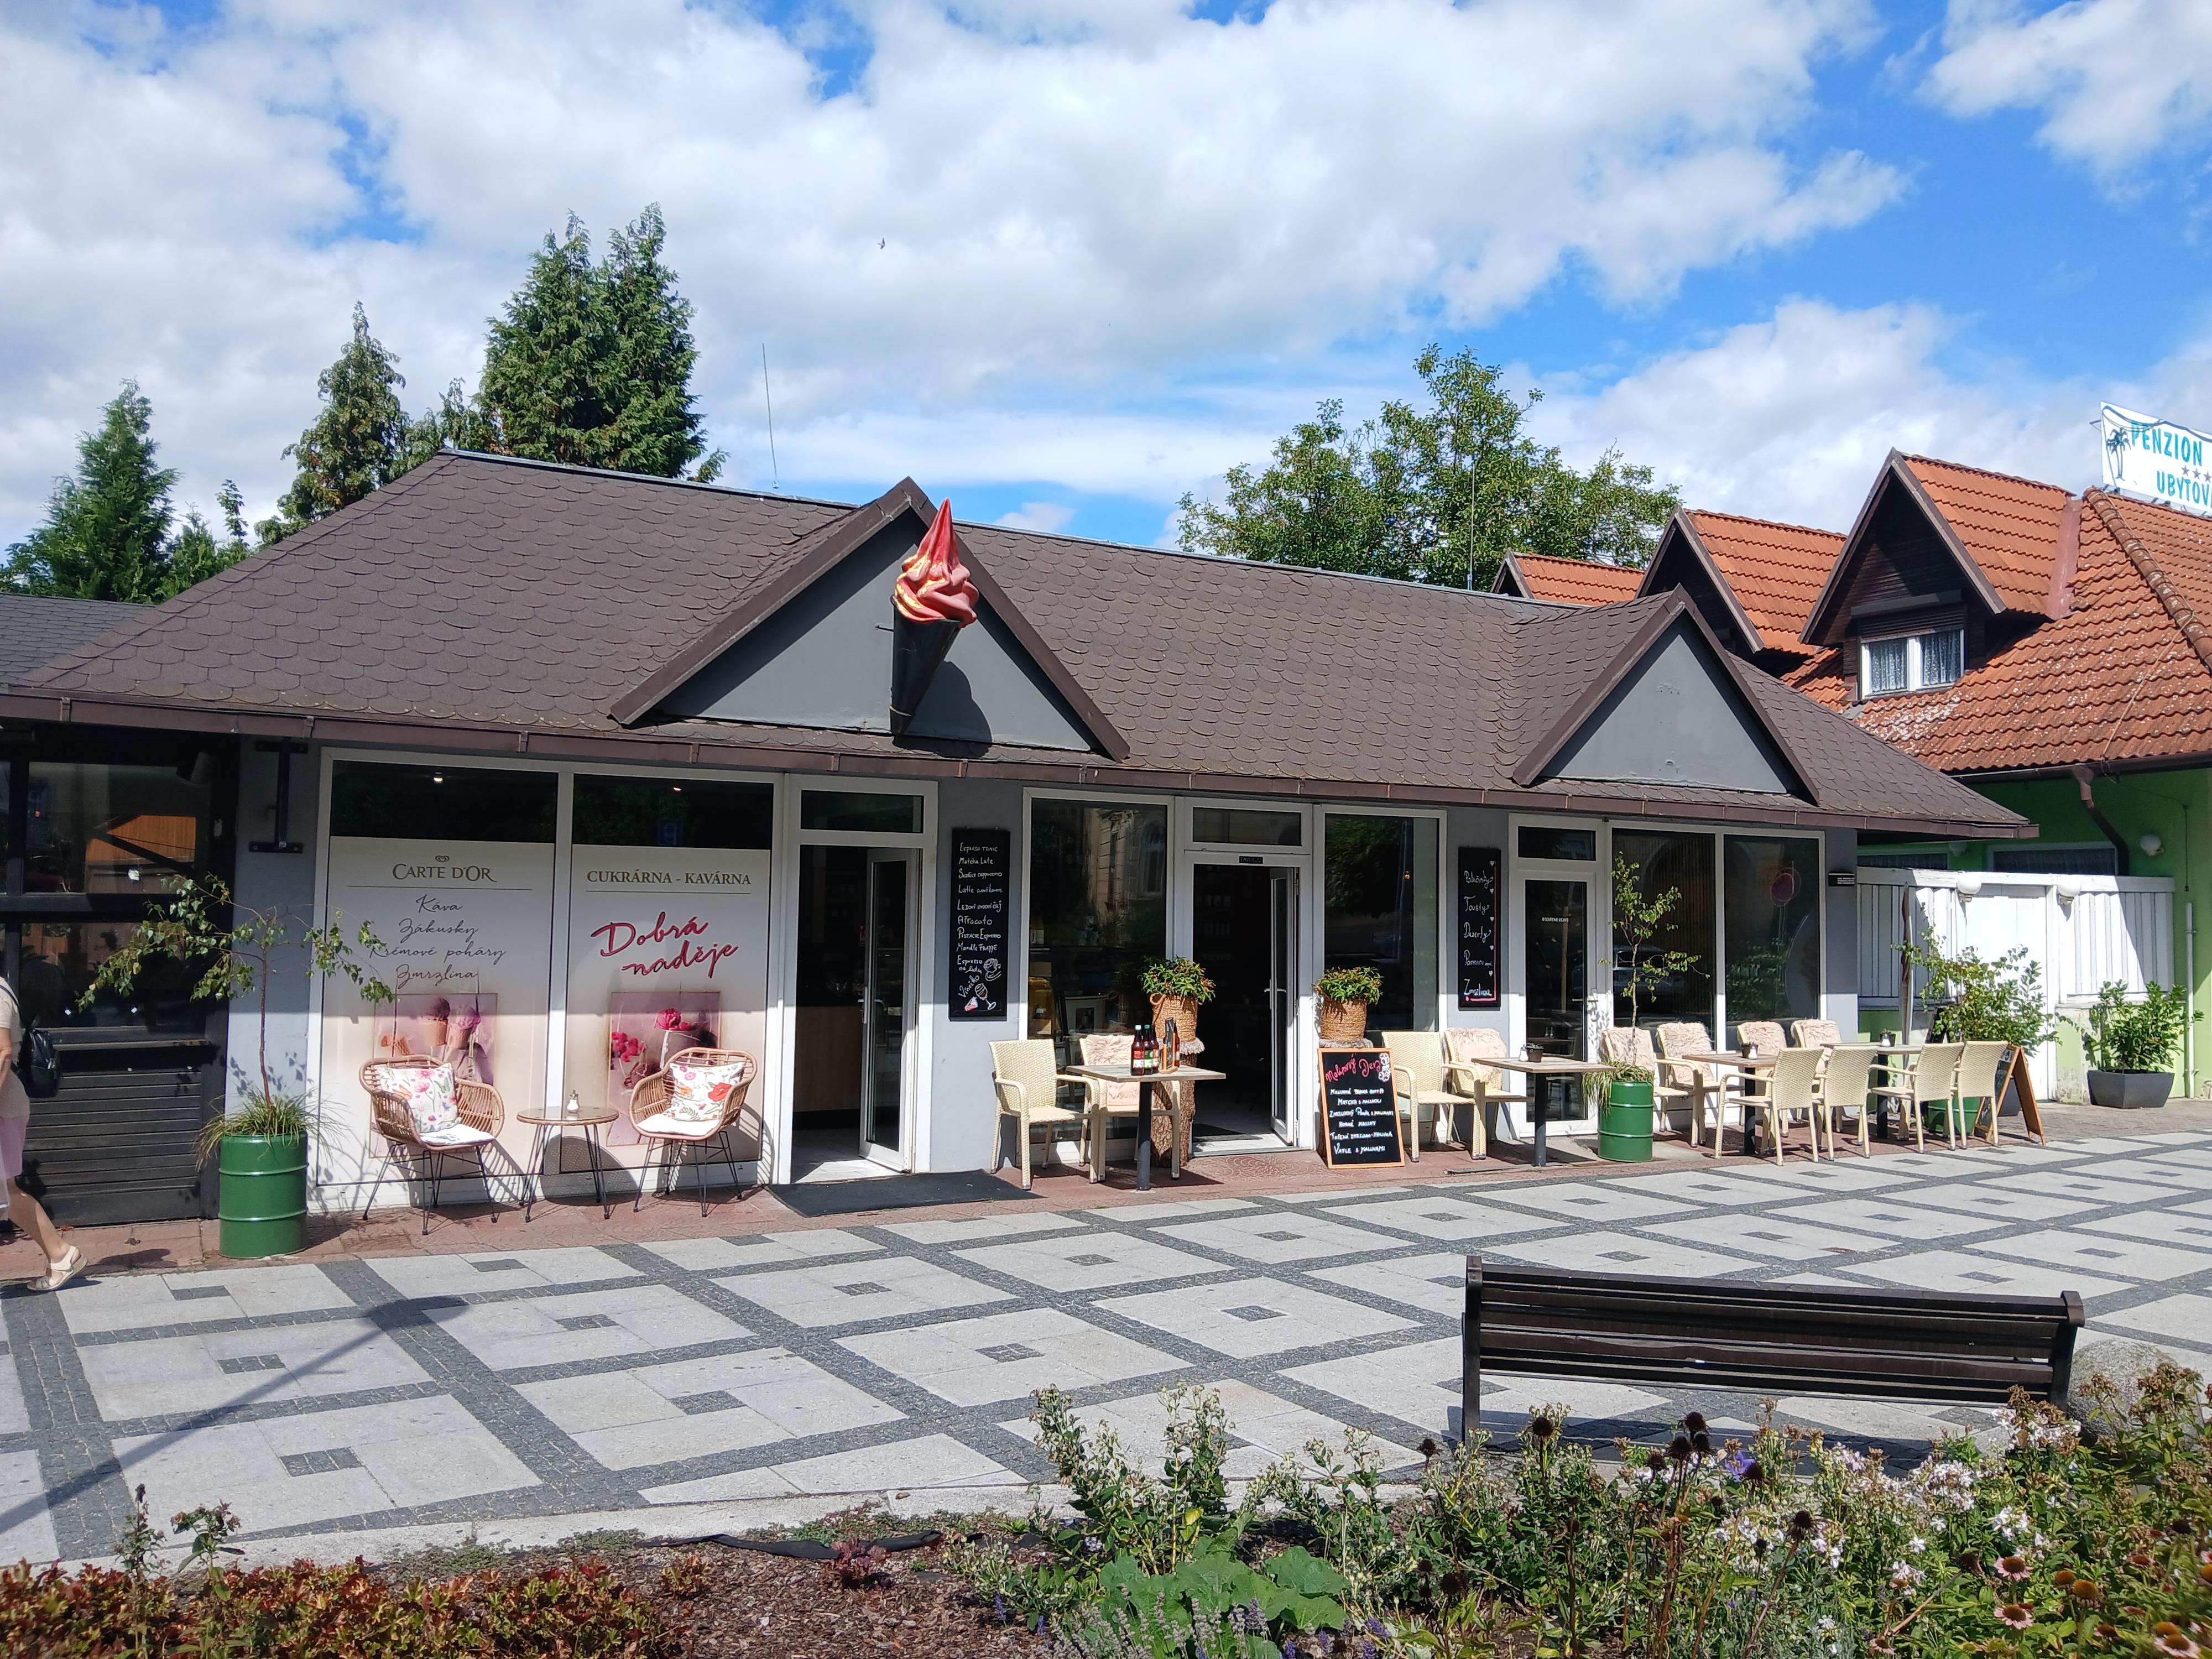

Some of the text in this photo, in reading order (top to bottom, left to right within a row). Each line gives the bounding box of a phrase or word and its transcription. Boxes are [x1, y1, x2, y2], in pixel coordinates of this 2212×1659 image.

[2132, 422, 2203, 467] PENZION
[2157, 471, 2212, 508] UBYTOV
[393, 863, 497, 883] CARTE D'OR
[587, 869, 672, 883] CUKRÁRNA
[685, 871, 752, 885] KAVÁRNA
[958, 884, 974, 893] Latte
[416, 894, 462, 913] Káva
[1464, 895, 1490, 915] Tousty
[399, 918, 478, 943] Zákusky
[591, 911, 709, 957] Dobrá
[367, 941, 507, 965] Krémové poháry
[621, 940, 739, 978] naděje
[957, 954, 983, 966] Espresso
[396, 964, 478, 989] Zmrzlina
